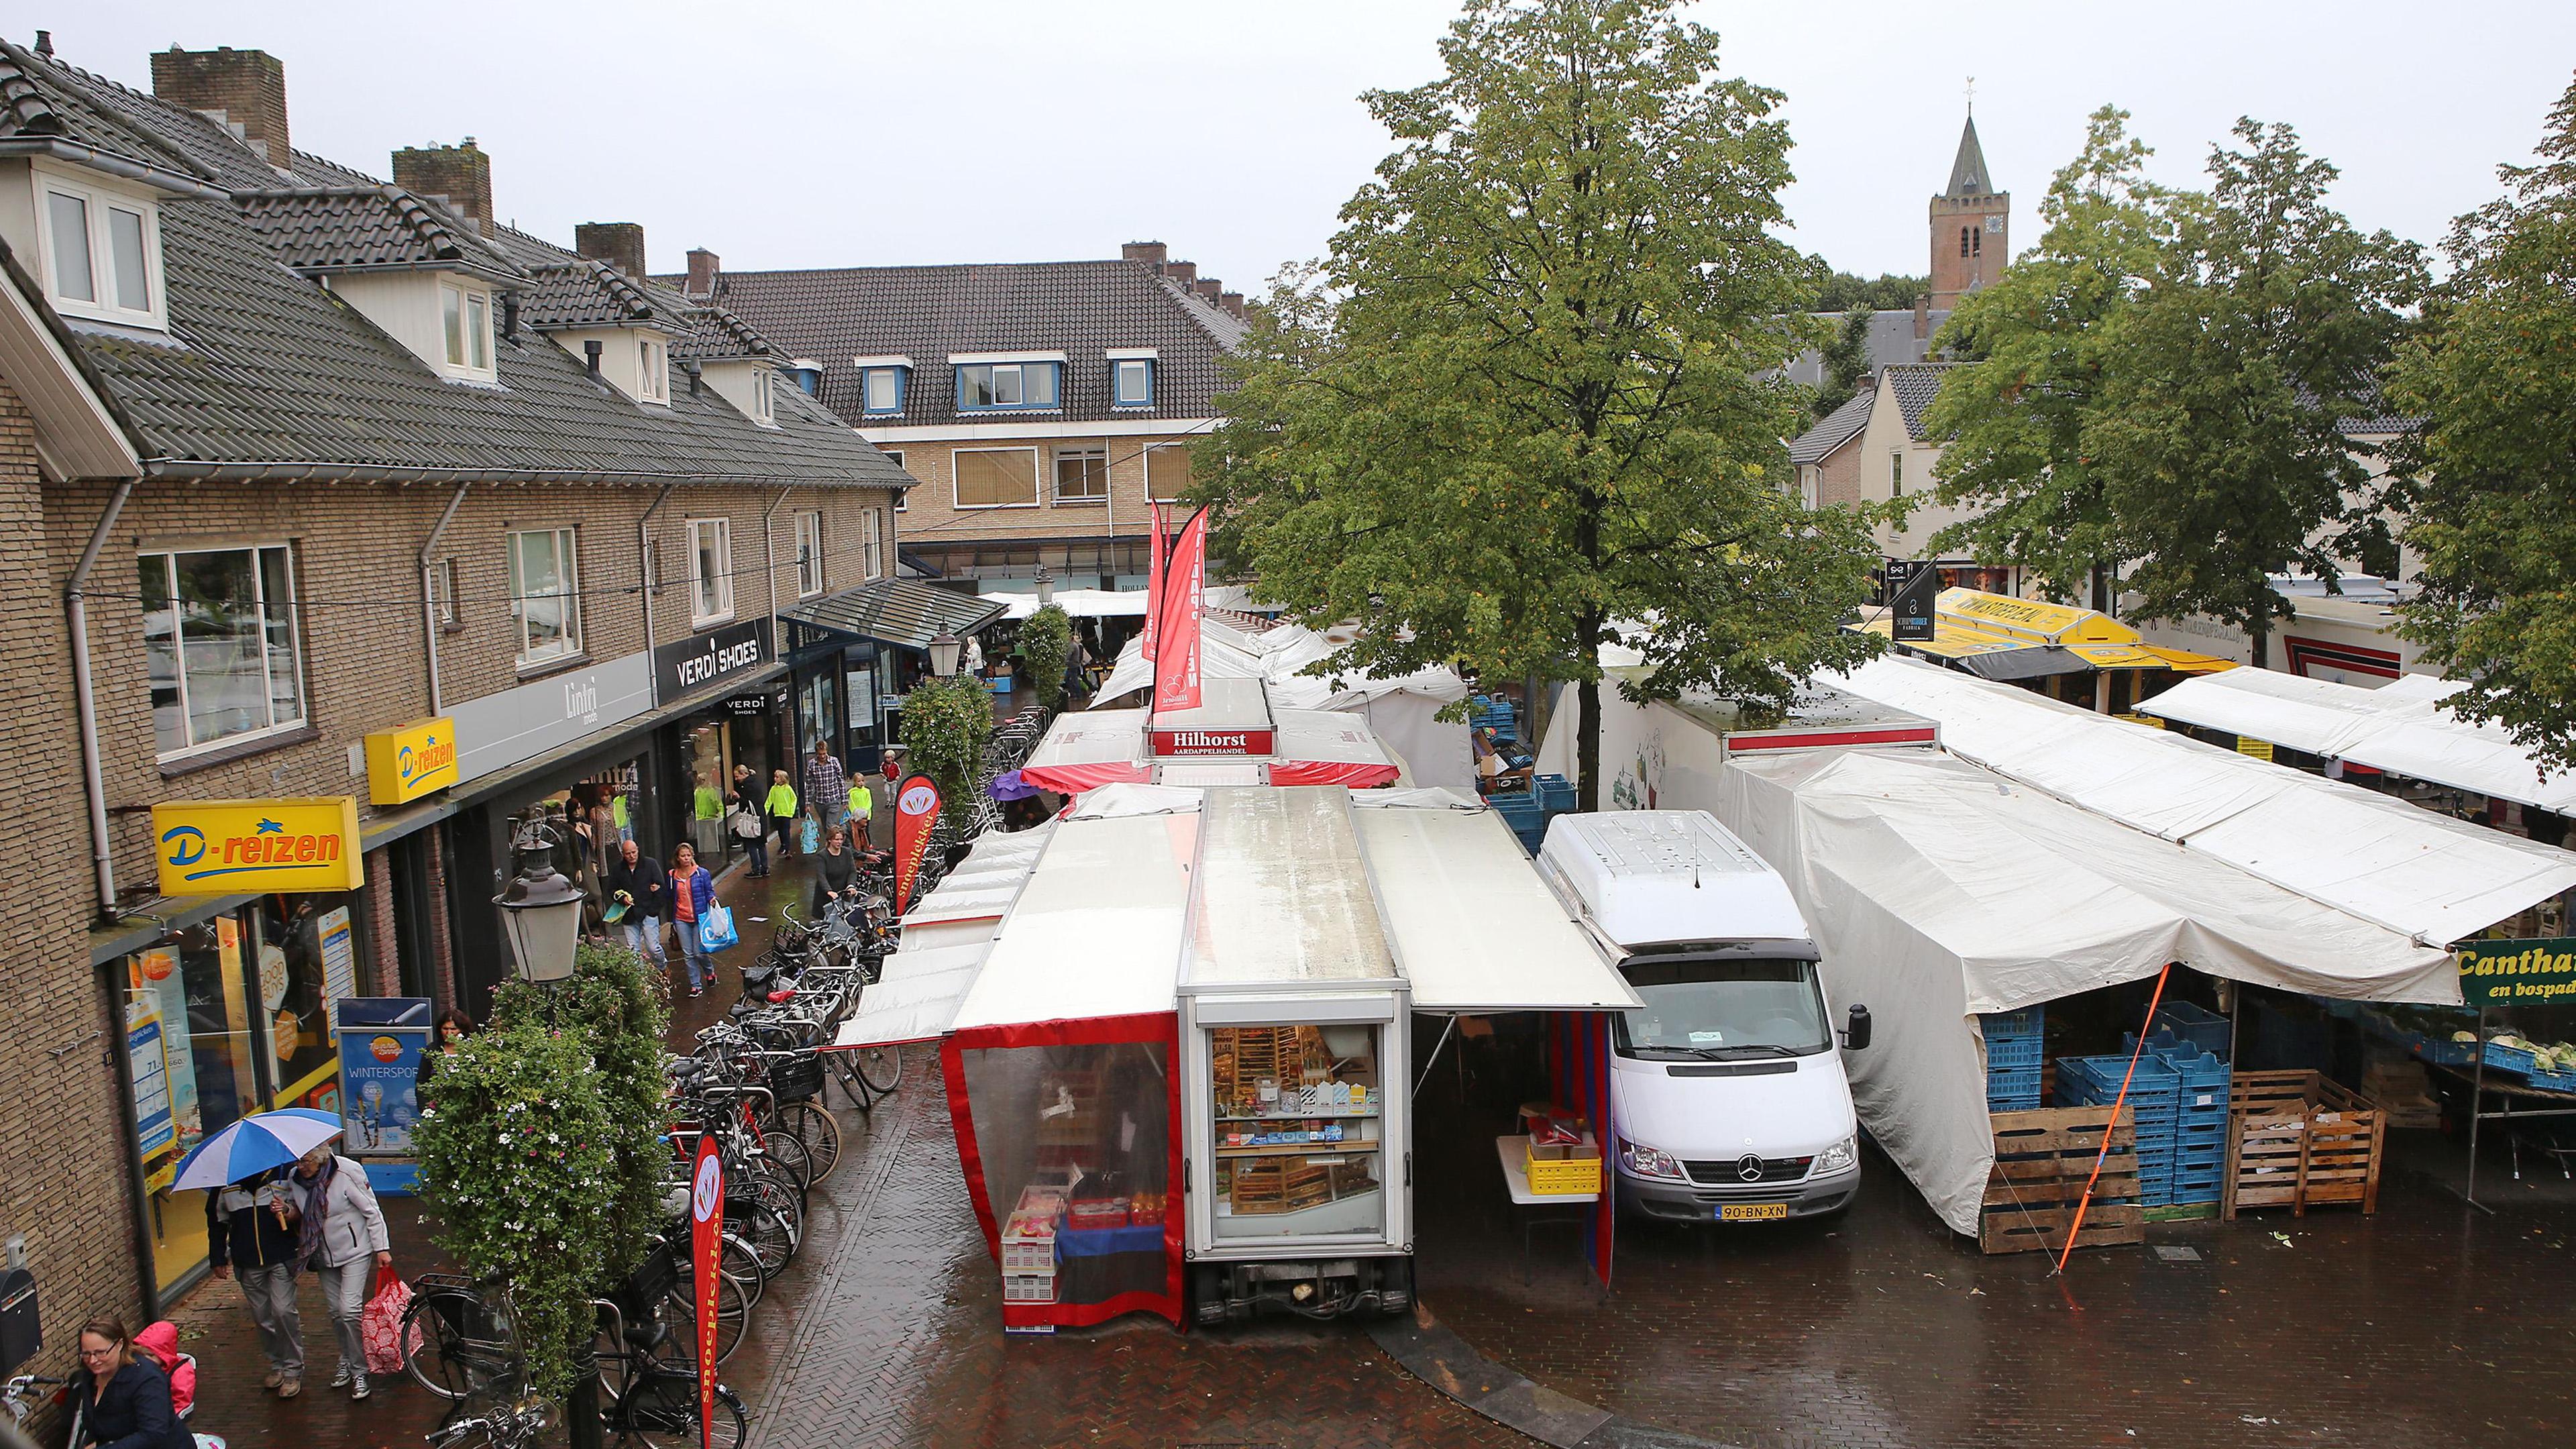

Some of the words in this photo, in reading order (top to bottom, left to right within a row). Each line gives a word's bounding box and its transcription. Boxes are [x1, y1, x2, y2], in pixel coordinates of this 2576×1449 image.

[718, 639, 757, 673] SHOES
[565, 676, 597, 719] Lintri
[398, 735, 453, 778] D-reizen
[1173, 732, 1246, 747] Hilhorst
[162, 818, 340, 866] D-reizen
[898, 812, 934, 898] snoeplekker
[2489, 986, 2511, 997] en
[1725, 1206, 1784, 1218] 90-BN-XN
